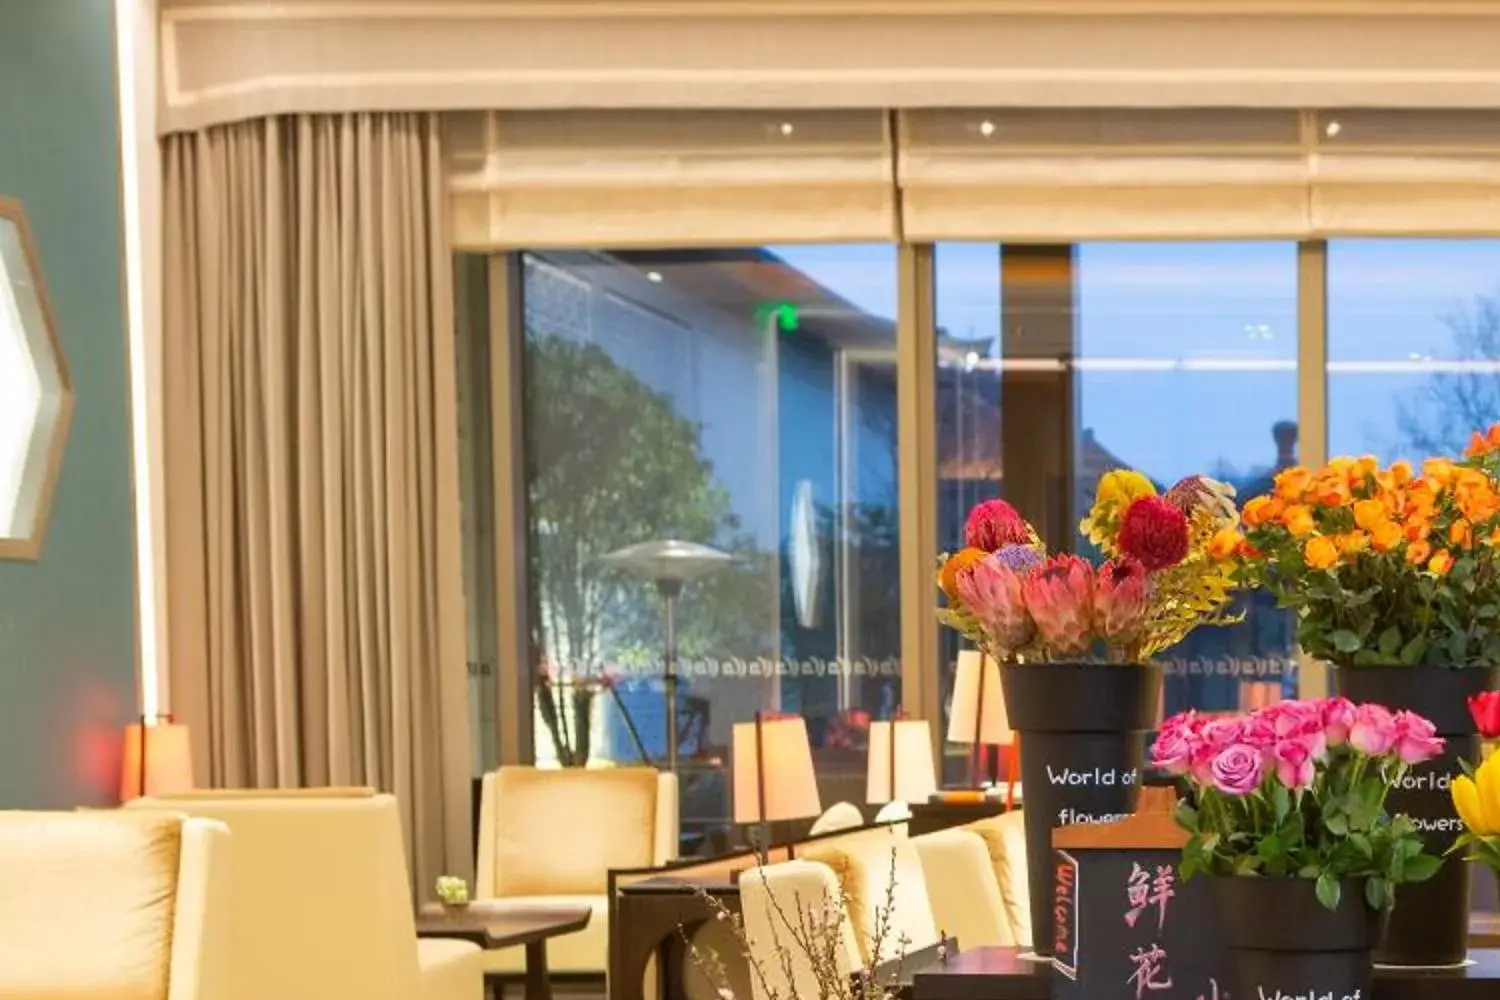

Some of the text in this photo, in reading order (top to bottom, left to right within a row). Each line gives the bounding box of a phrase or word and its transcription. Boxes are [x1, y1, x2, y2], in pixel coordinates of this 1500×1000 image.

[1046, 765, 1137, 785] World of
[1381, 764, 1452, 791] World
[1058, 808, 1137, 825] flower
[1411, 817, 1464, 831] owers
[1054, 863, 1073, 953] Welcome
